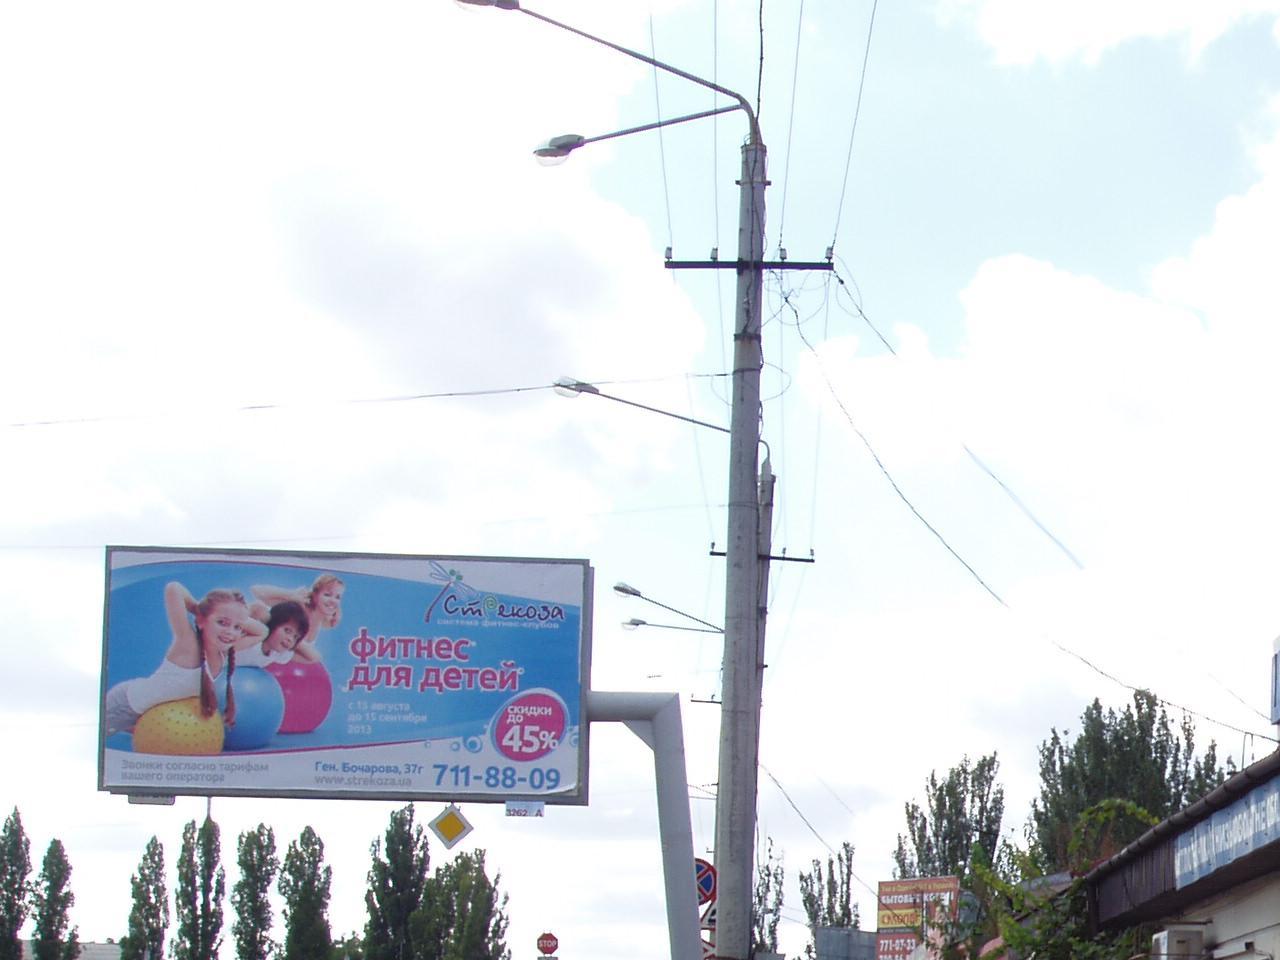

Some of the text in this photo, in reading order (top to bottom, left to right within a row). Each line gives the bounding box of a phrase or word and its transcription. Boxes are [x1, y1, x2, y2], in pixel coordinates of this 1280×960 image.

[349, 628, 471, 664] фитнес
[348, 660, 520, 694] для детей
[502, 725, 558, 752] 45%
[165, 762, 216, 772] согласно
[219, 763, 269, 774] тарифам
[315, 761, 424, 775] Ген. Бочарова, 37г
[165, 773, 225, 785] оператора
[314, 774, 412, 786] www.strekoza.ua
[432, 764, 560, 790] 711-88-09
[539, 938, 557, 948] STOP
